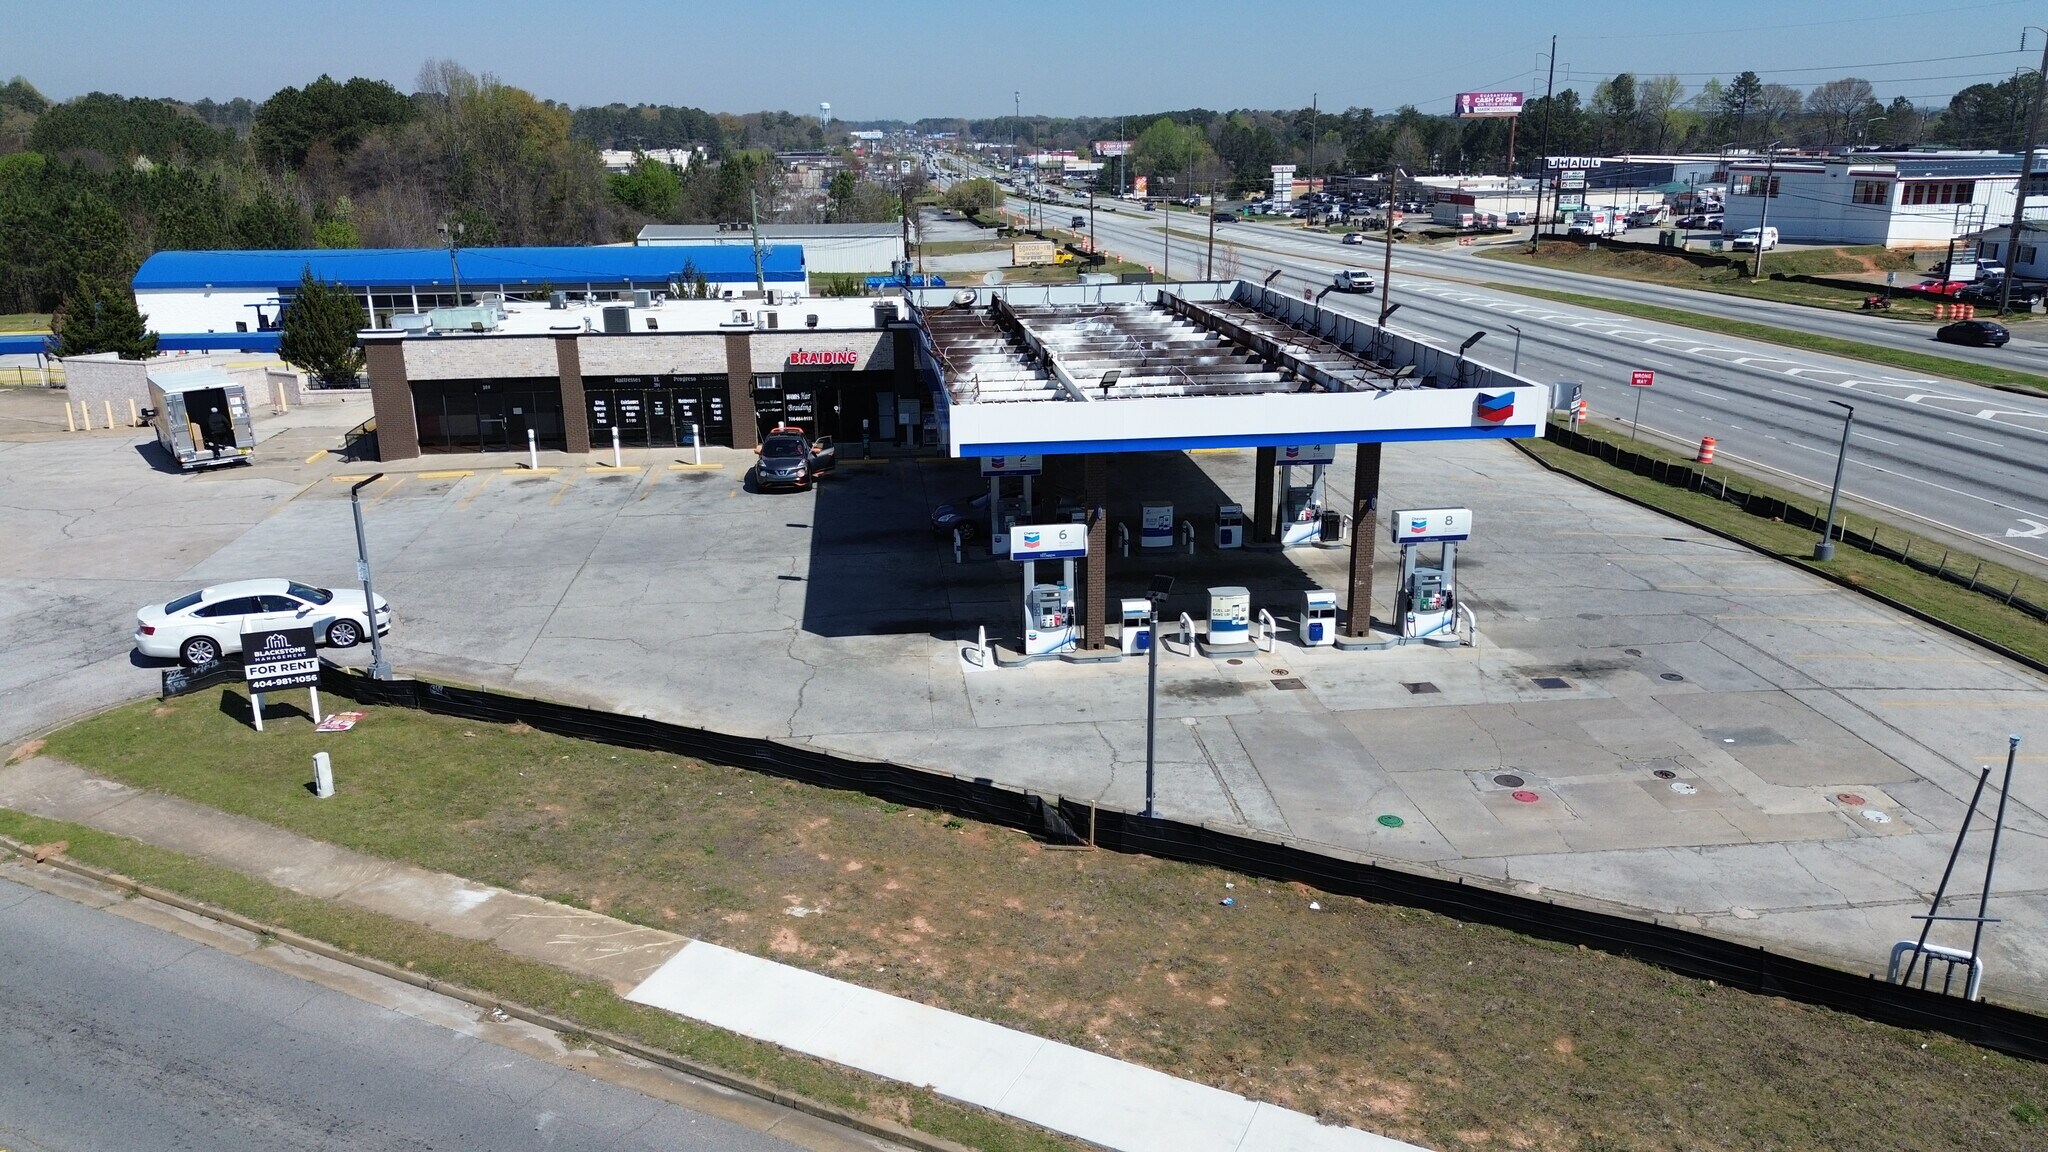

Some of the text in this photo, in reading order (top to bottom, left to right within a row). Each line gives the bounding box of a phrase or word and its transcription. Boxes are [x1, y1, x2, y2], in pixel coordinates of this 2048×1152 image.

[790, 351, 858, 365] BRAIDING
[787, 402, 812, 413] Braiding
[1445, 515, 1453, 526] 8
[1059, 529, 1067, 540] 6
[254, 646, 307, 658] BLACKSTONE
[254, 652, 307, 662] MANAGEMENT
[250, 660, 316, 676] FOR RENT
[252, 674, 318, 689] 404-981-1056
